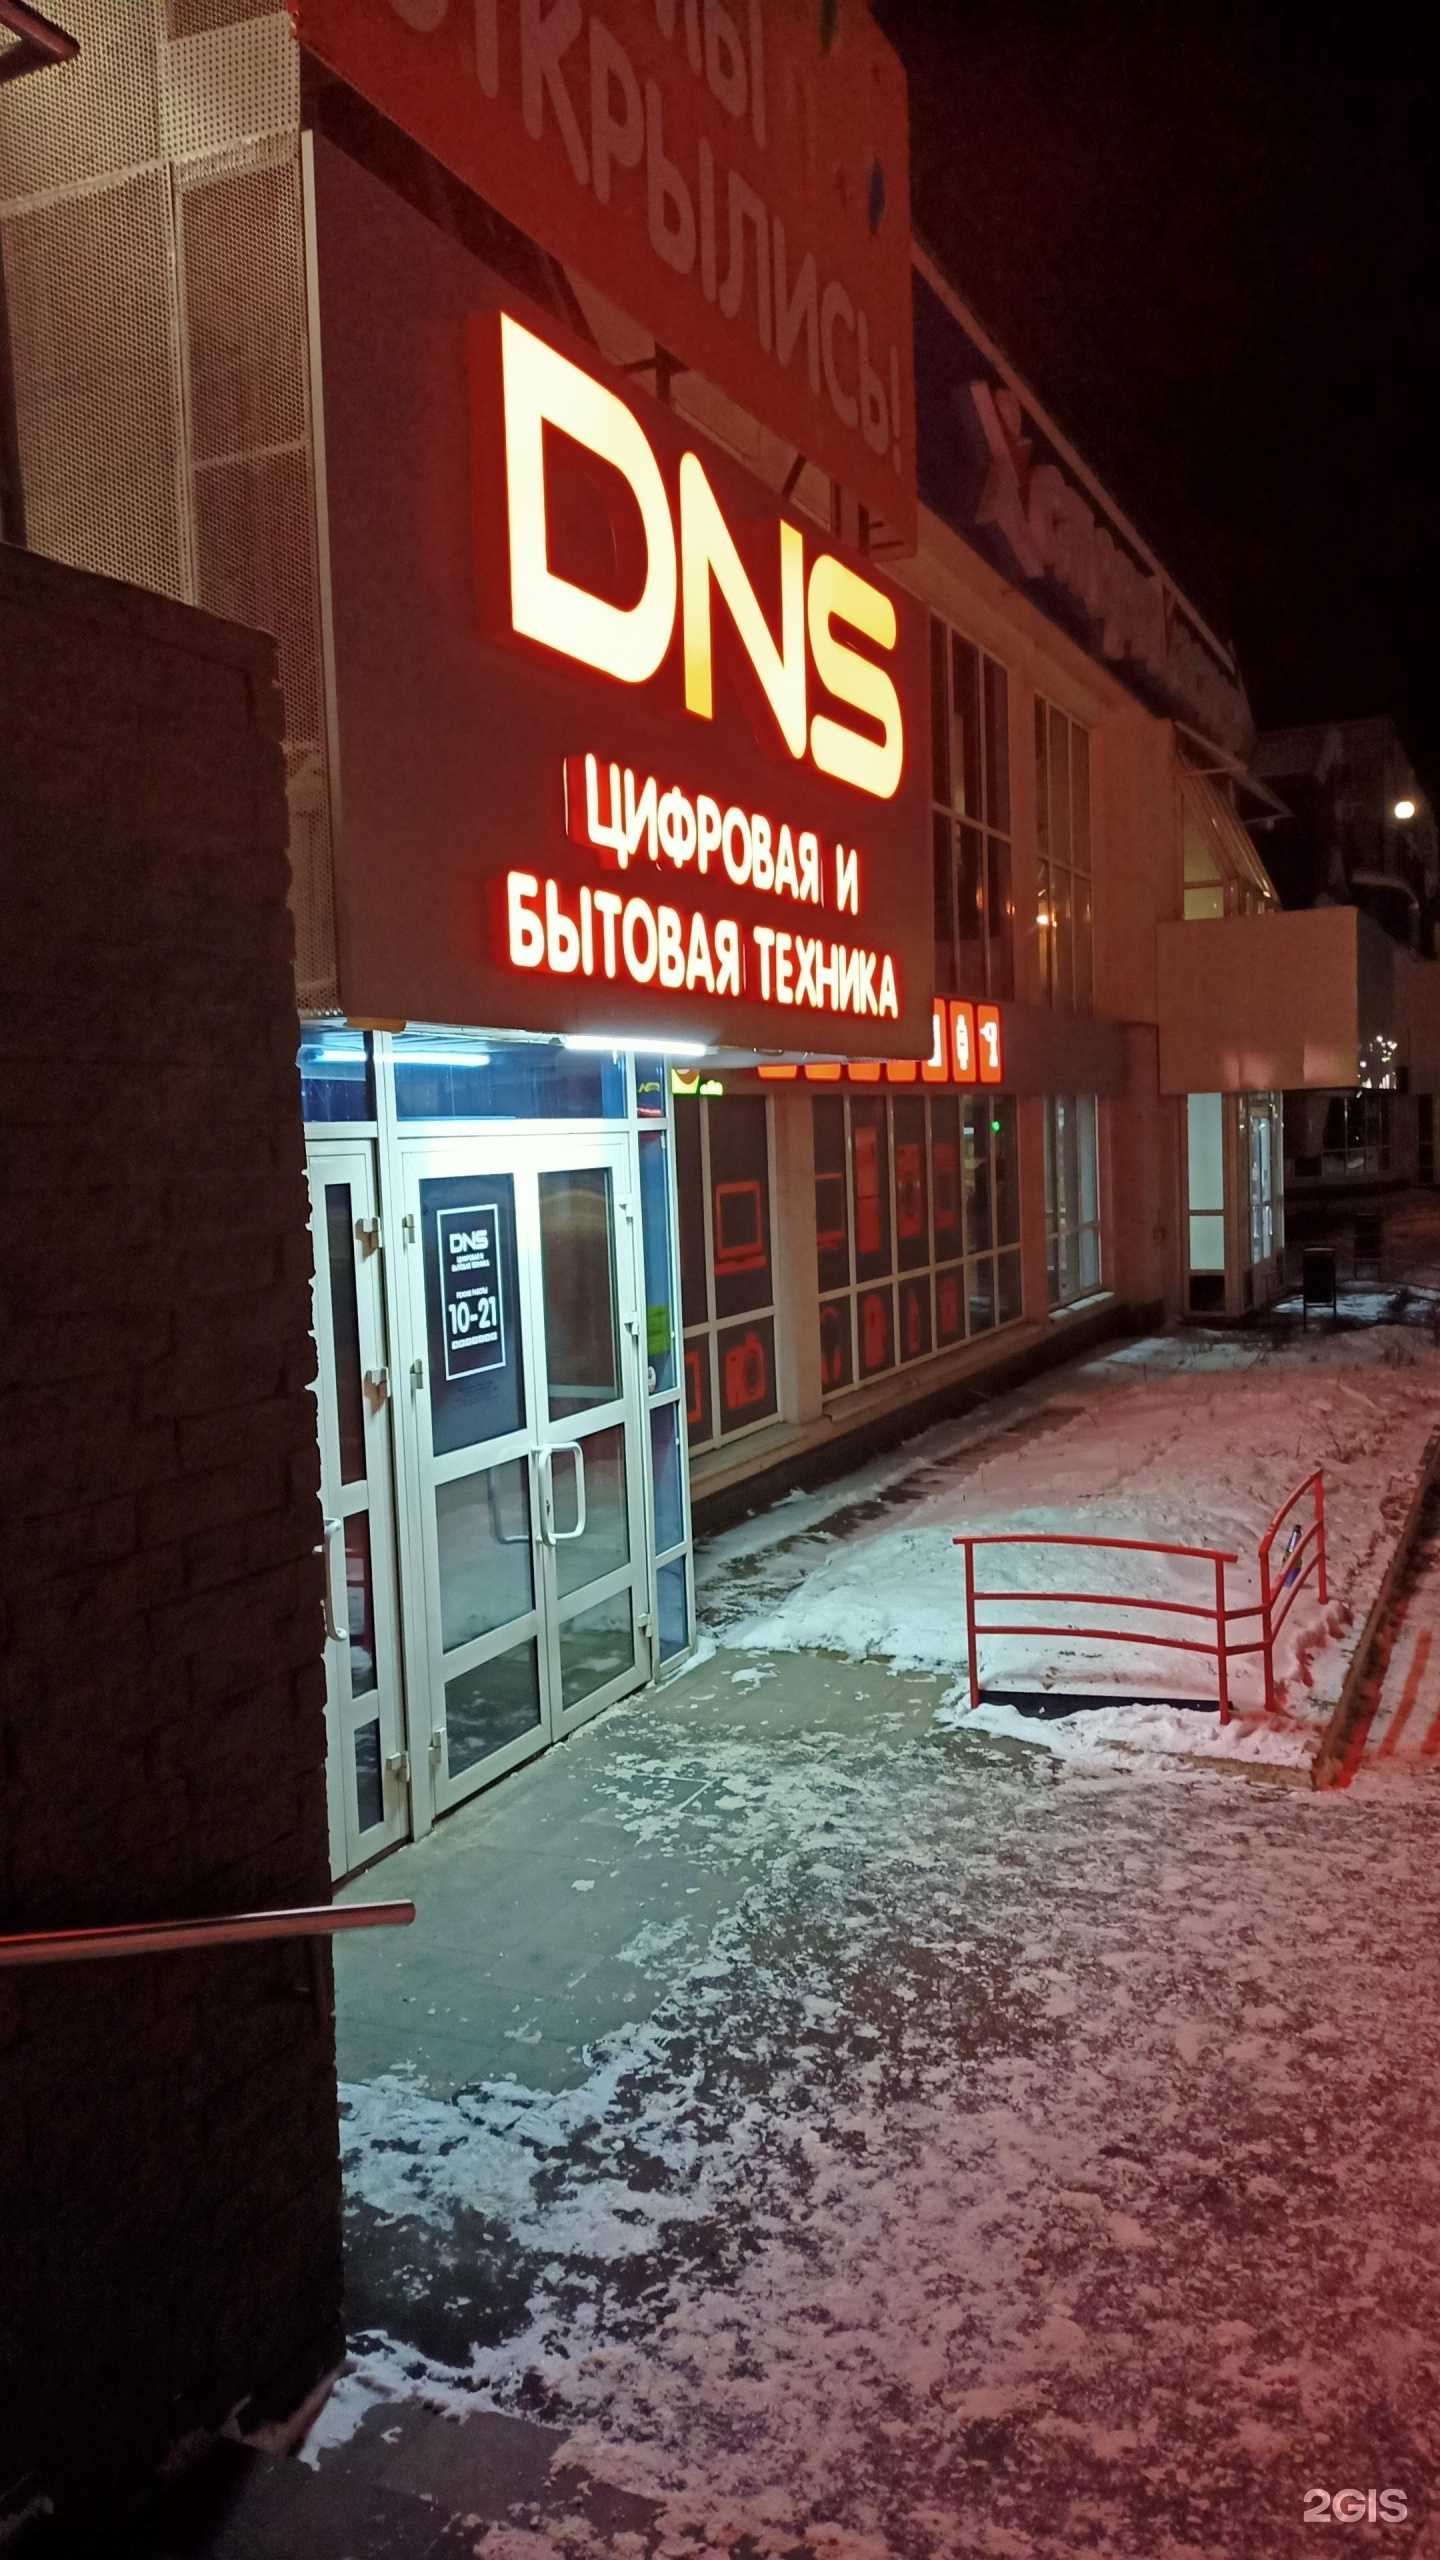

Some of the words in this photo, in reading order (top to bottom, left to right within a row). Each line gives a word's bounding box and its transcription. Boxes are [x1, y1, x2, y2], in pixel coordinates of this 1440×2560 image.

[386, 0, 902, 474] КРЫЛИСЬ!
[500, 312, 904, 799] DNS
[584, 753, 819, 905] ЦИФРОВАЯ
[836, 844, 860, 916] И
[506, 871, 744, 998] БЫТОВАЯ
[752, 925, 900, 1020] ТЕХНИКА
[448, 1296, 497, 1335] 10-21
[449, 1229, 489, 1254] DNS
